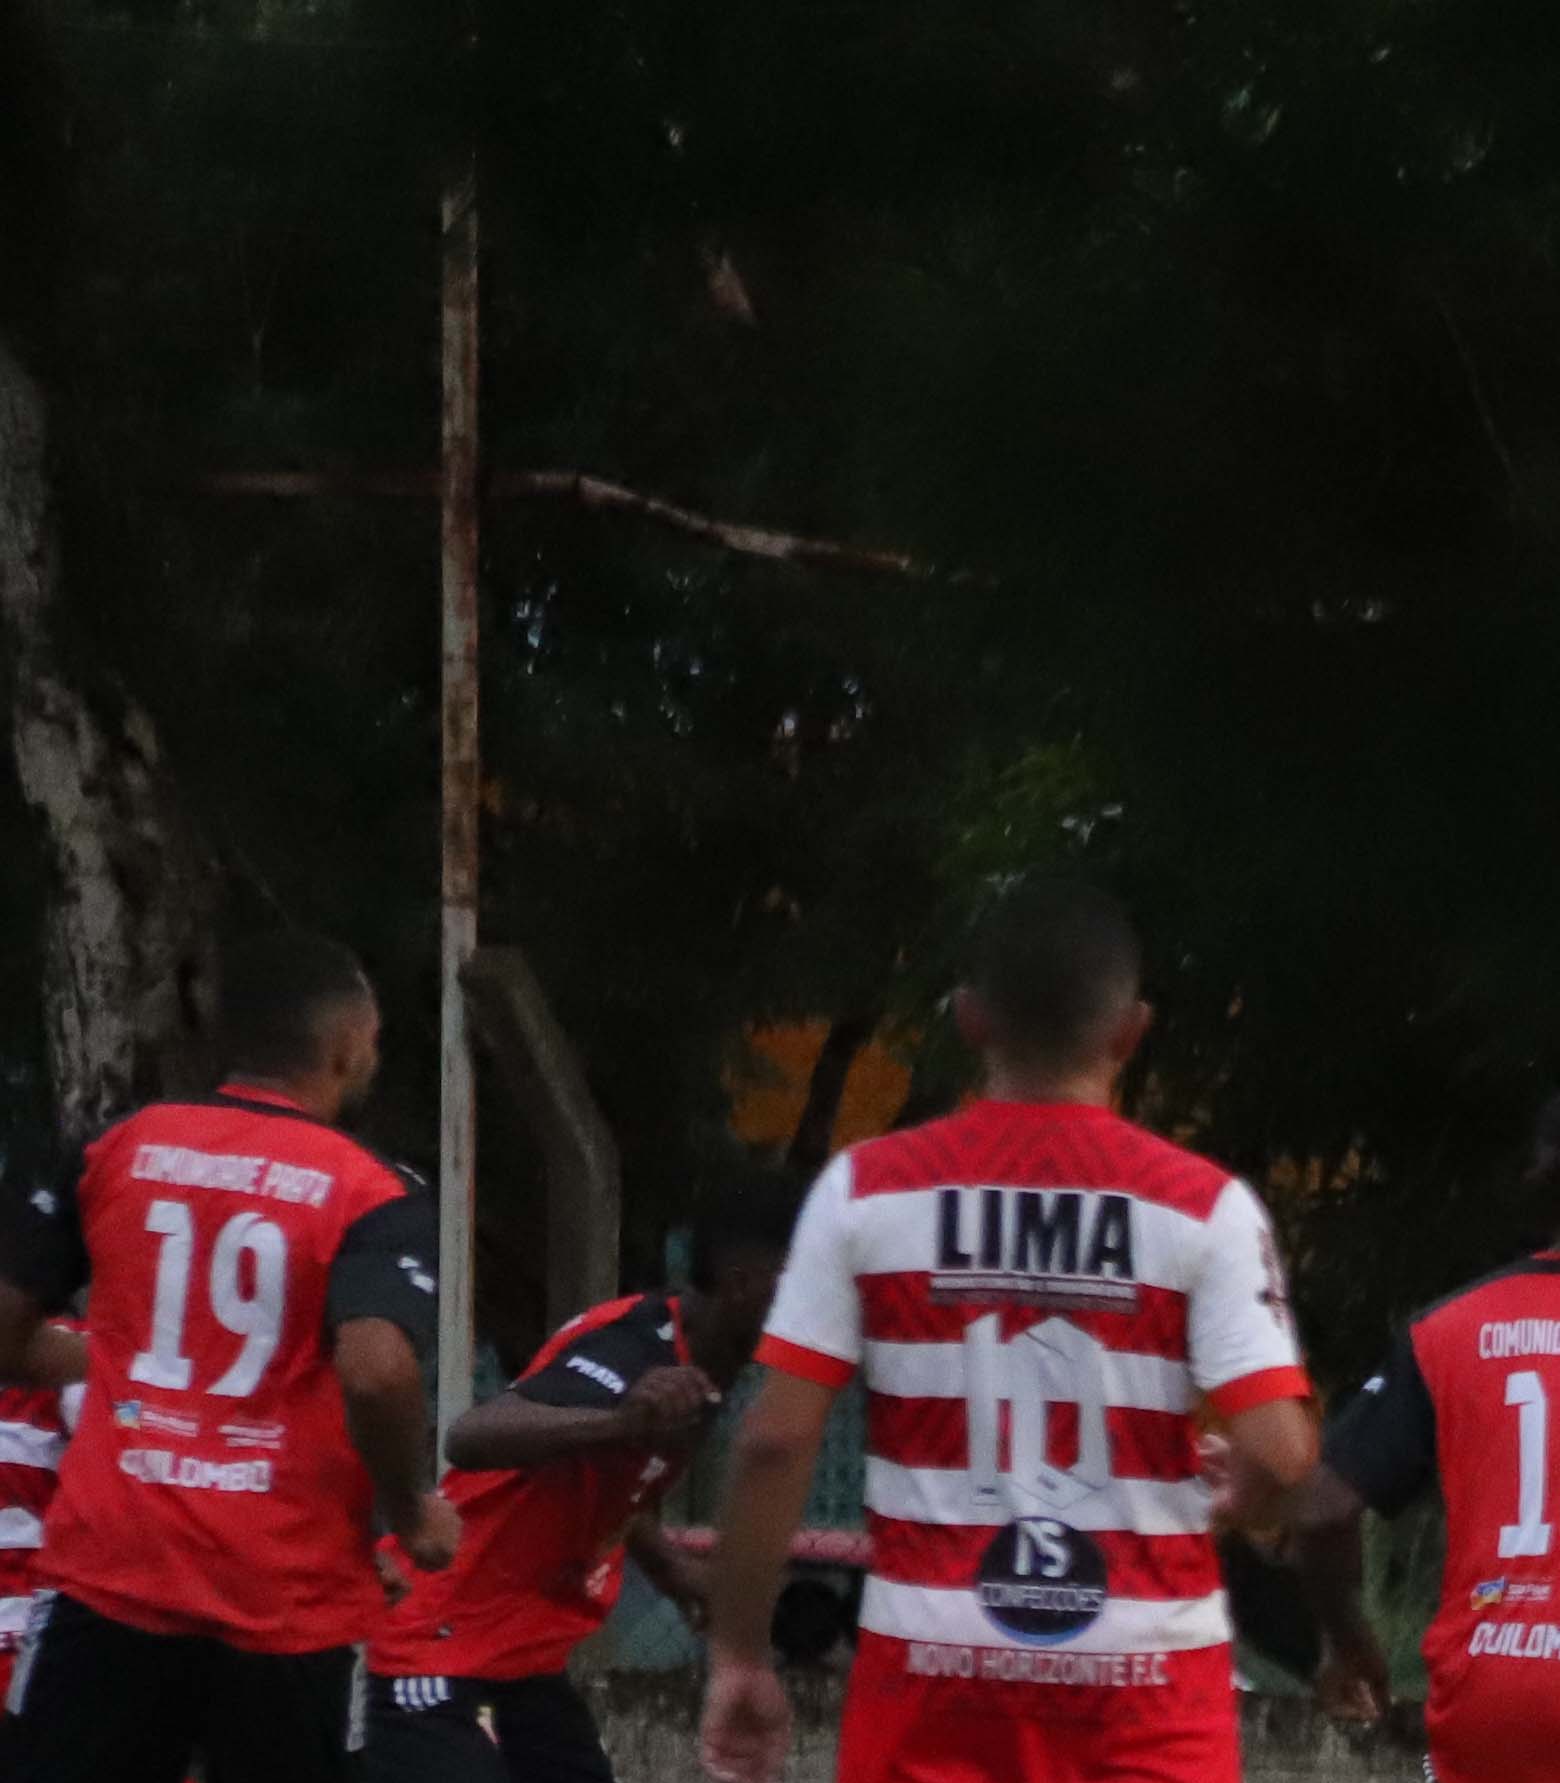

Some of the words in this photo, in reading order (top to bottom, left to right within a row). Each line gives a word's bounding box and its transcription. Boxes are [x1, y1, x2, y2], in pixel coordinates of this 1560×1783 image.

[129, 1200, 288, 1398] 19
[940, 1188, 1135, 1280] LIMA
[964, 1312, 1114, 1510] 10
